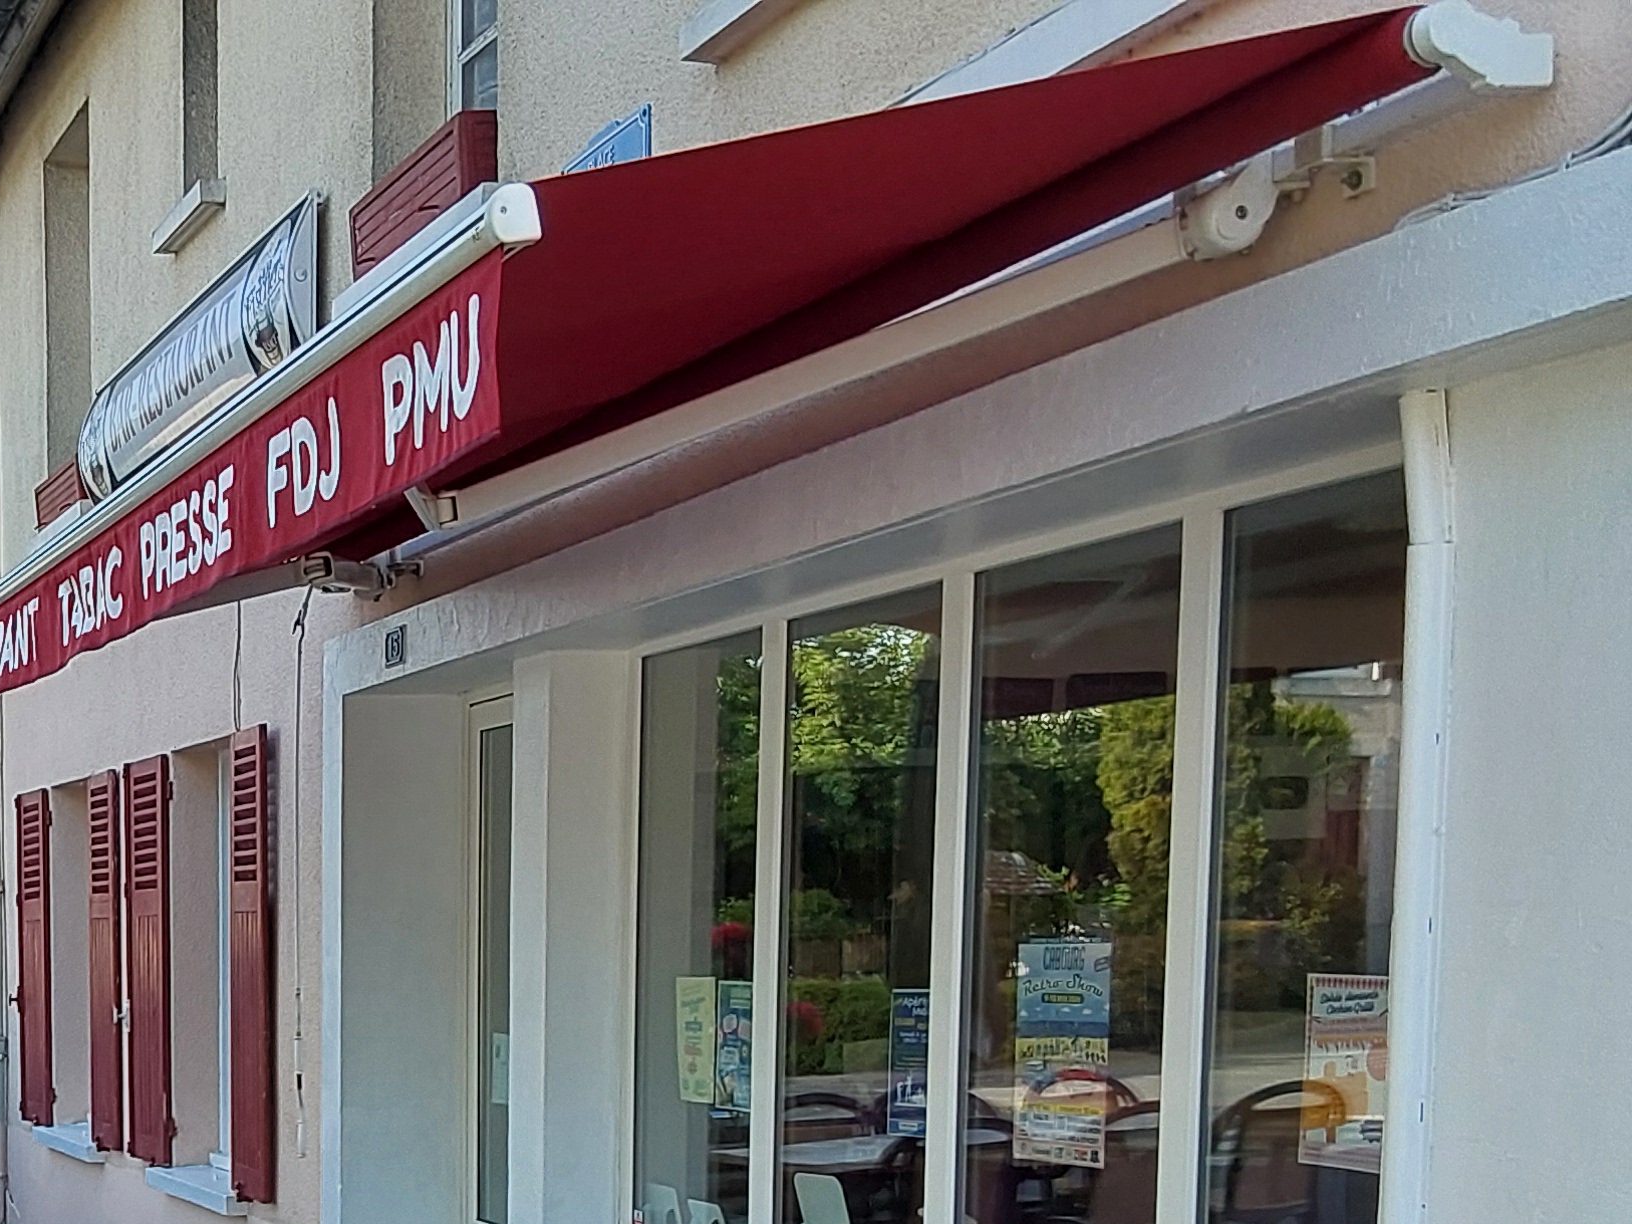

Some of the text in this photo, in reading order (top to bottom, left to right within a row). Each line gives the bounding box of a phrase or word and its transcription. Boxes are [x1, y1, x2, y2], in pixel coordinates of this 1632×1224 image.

[58, 545, 123, 647] TABAC
[139, 463, 234, 600] PRESSE
[266, 396, 341, 529] FDJ
[382, 293, 480, 466] PMU
[1043, 946, 1086, 971] CABOURG
[1023, 973, 1103, 997] Retro Show
